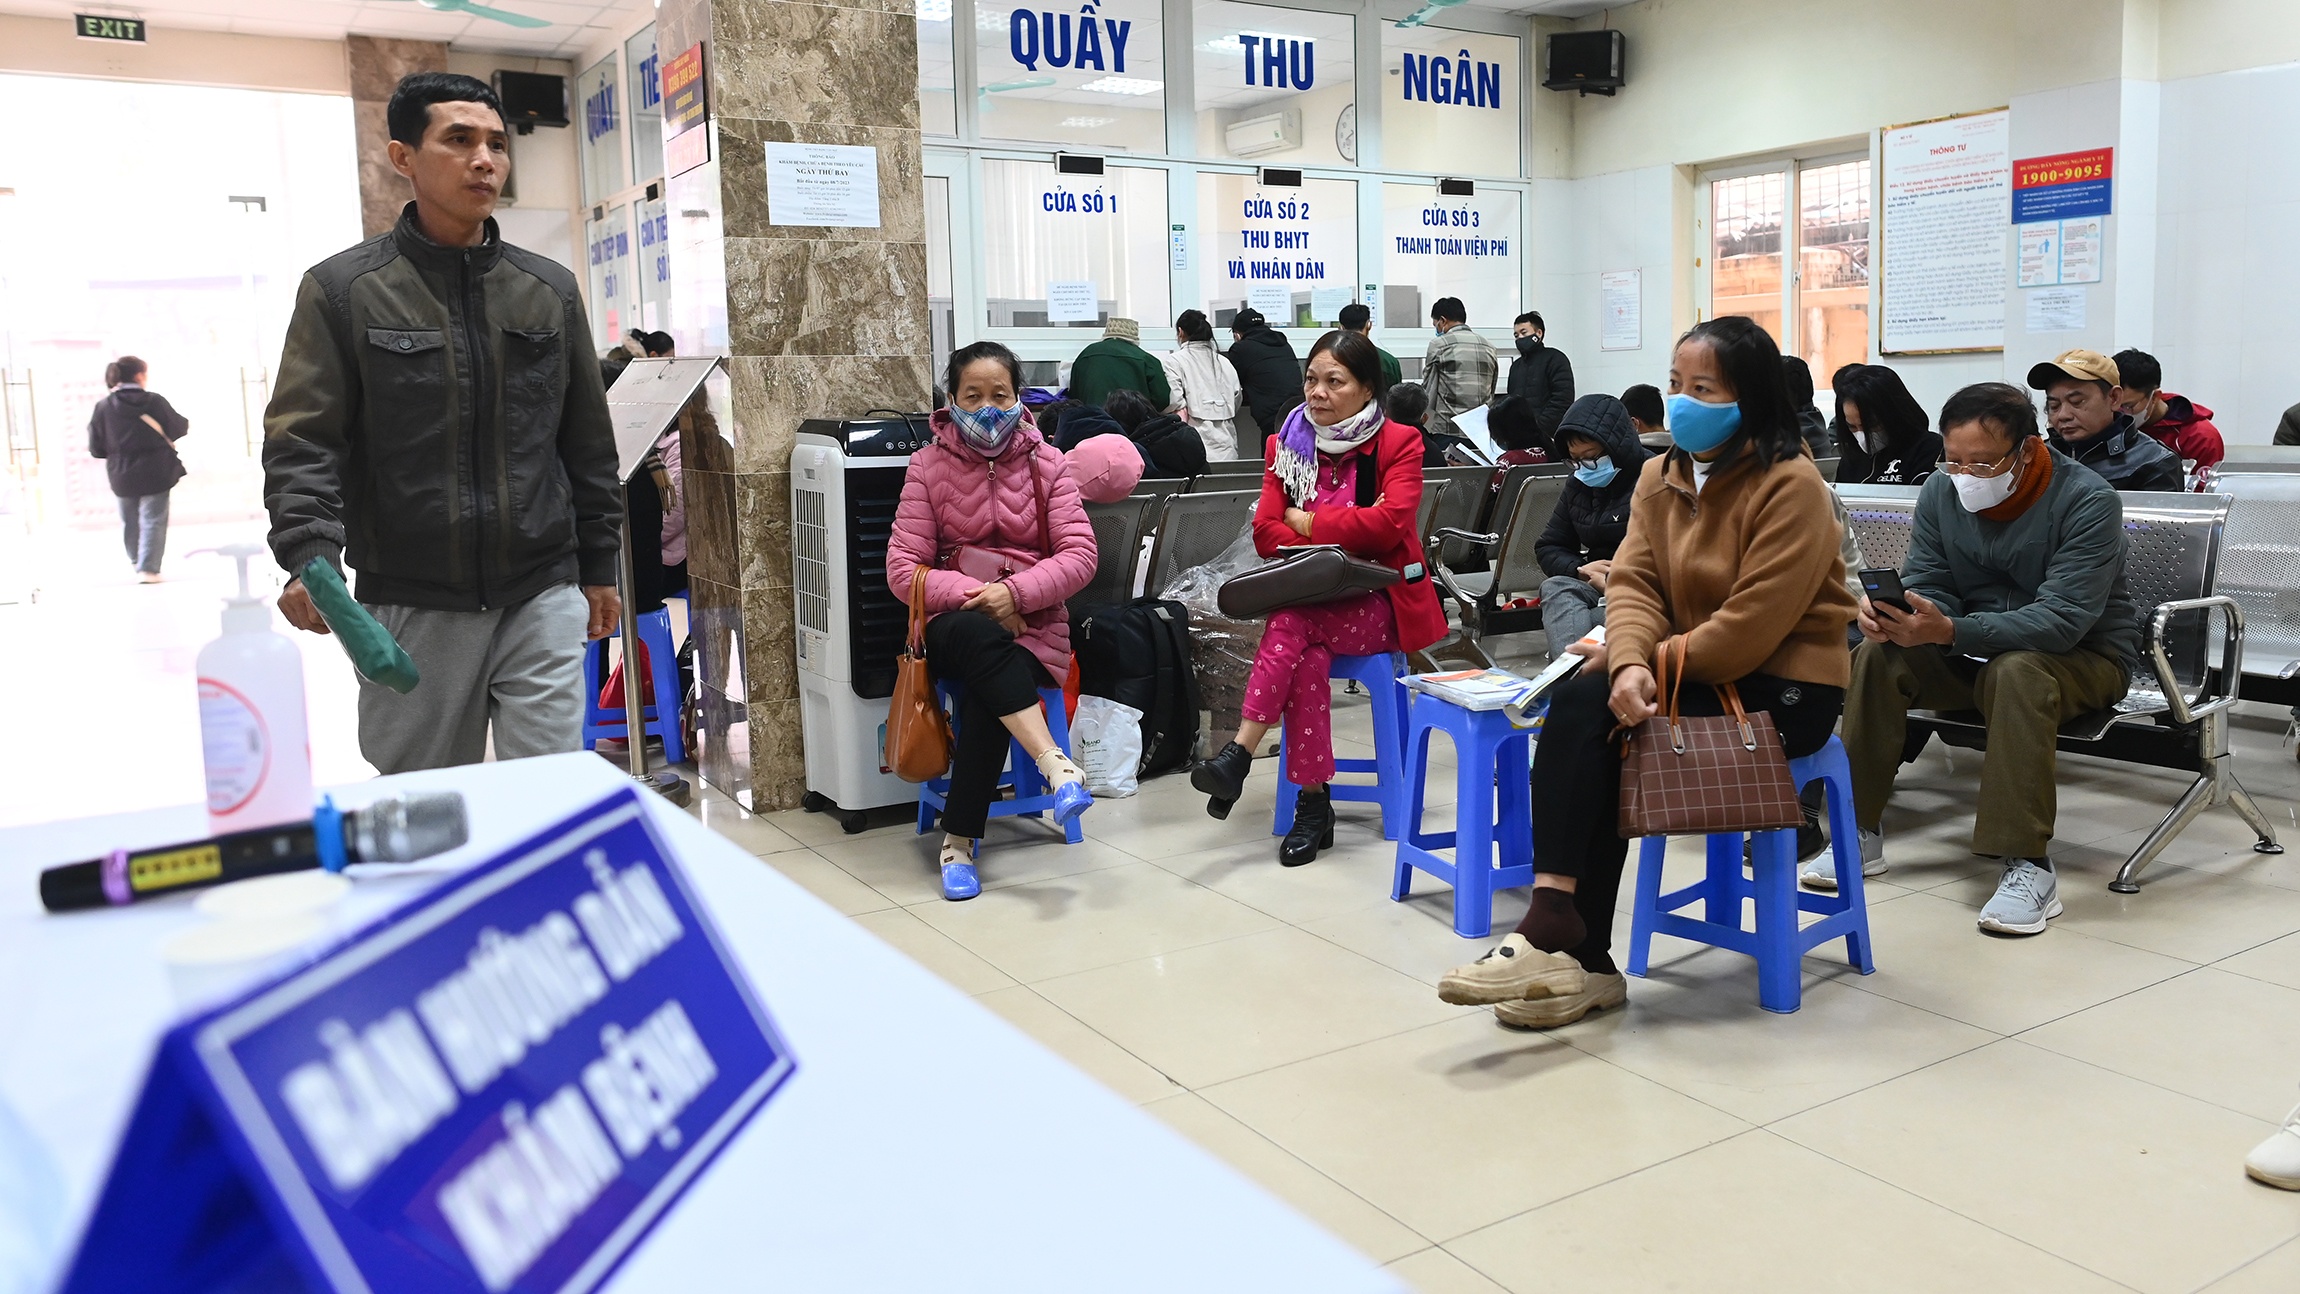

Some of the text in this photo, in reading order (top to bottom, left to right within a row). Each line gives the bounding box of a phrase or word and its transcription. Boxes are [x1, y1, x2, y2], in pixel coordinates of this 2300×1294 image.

[84, 17, 138, 39] EXIT
[1010, 0, 1500, 110] QUẦY THU NGÂN
[1929, 143, 1967, 156] THÔNG TƯ
[2022, 163, 2103, 186] 1900-9095
[1042, 184, 1117, 213] CỬA SỐ 1
[1243, 192, 1310, 220] CỬA SỐ 2
[1422, 202, 1480, 228] CỬA SỐ 3
[1241, 230, 1310, 249] THU BHYT
[1395, 234, 1508, 260] THANH TOÁN VIỆN PHÍ
[1227, 255, 1324, 279] VÀ NHÂN DÂN
[414, 922, 611, 1094] HƯỚNG
[436, 998, 719, 1292] KHÁM BỆNH
